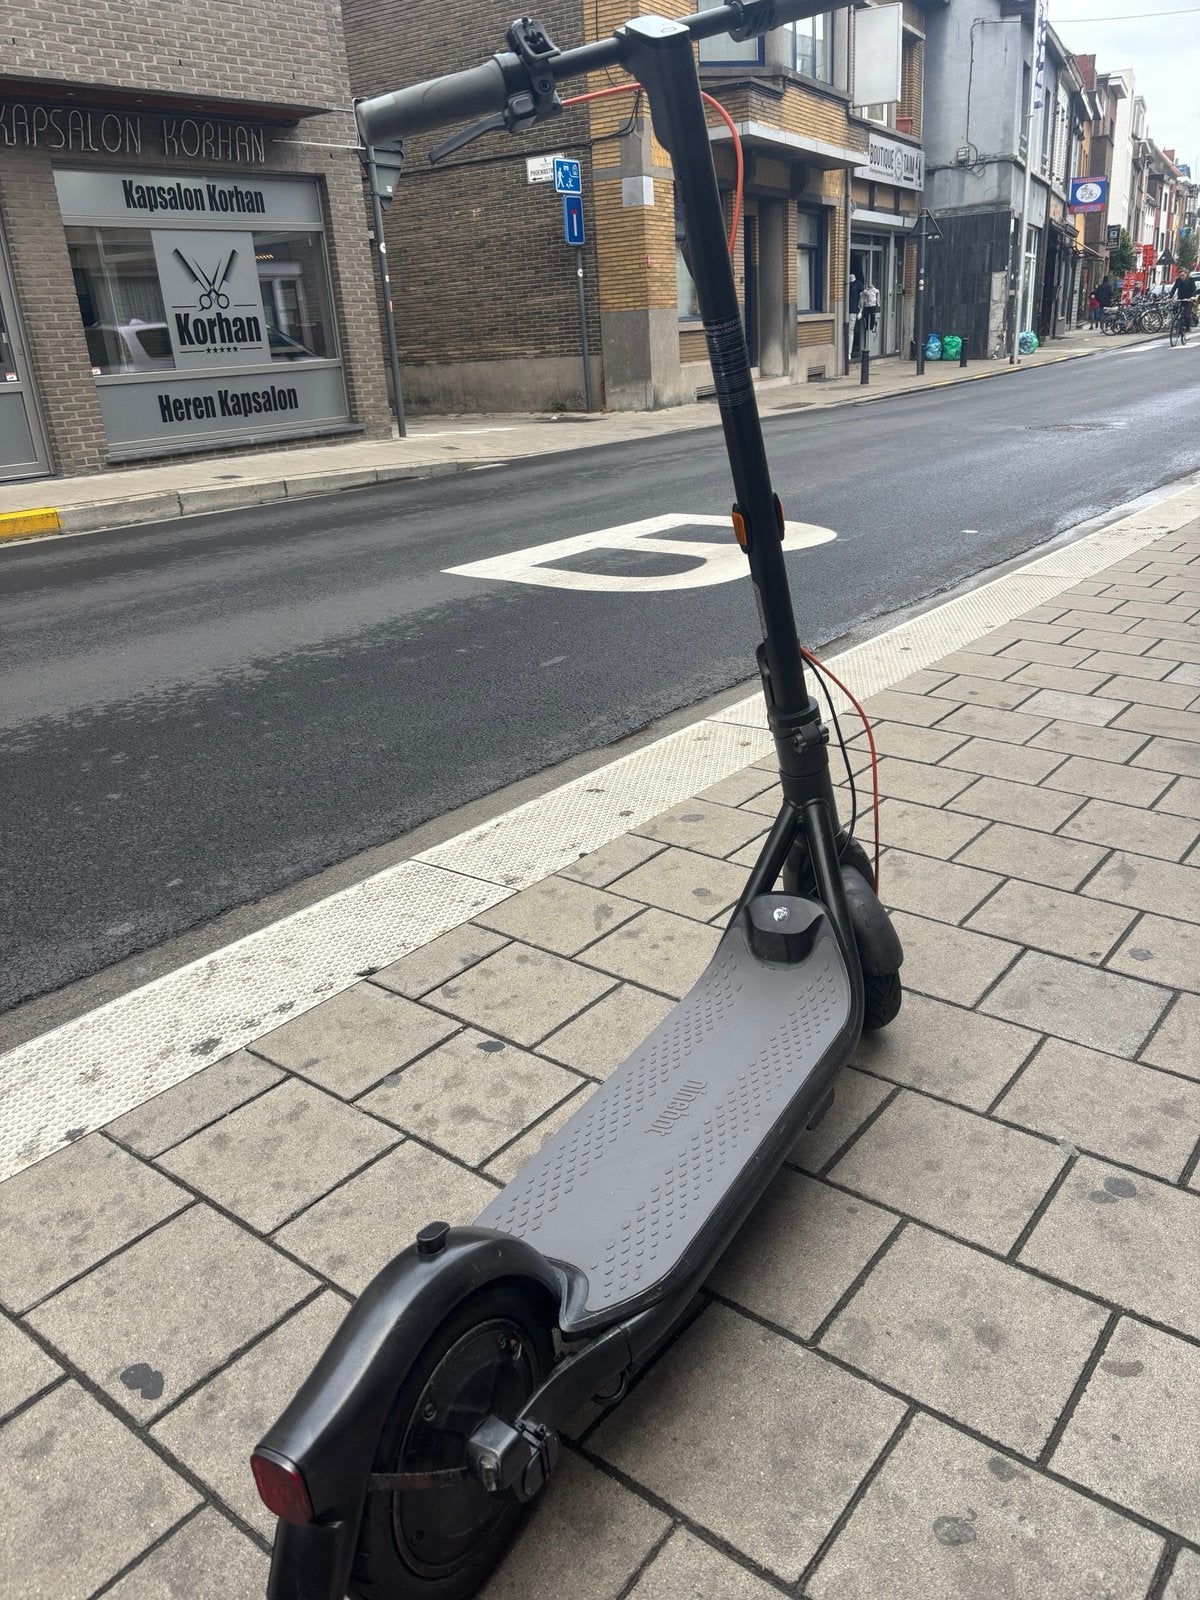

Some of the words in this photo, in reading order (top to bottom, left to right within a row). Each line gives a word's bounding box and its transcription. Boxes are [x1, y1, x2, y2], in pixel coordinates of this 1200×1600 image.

[0, 104, 141, 154] KAPSALON
[163, 119, 265, 163] KORHAN
[870, 143, 894, 170] BOUTIQUE
[122, 179, 206, 212] Kapsalon
[206, 184, 266, 213] Korhan
[175, 312, 262, 346] Korhan
[158, 394, 217, 423] Heren
[218, 385, 299, 417] Kapsalon
[643, 1079, 708, 1137] ninebot
